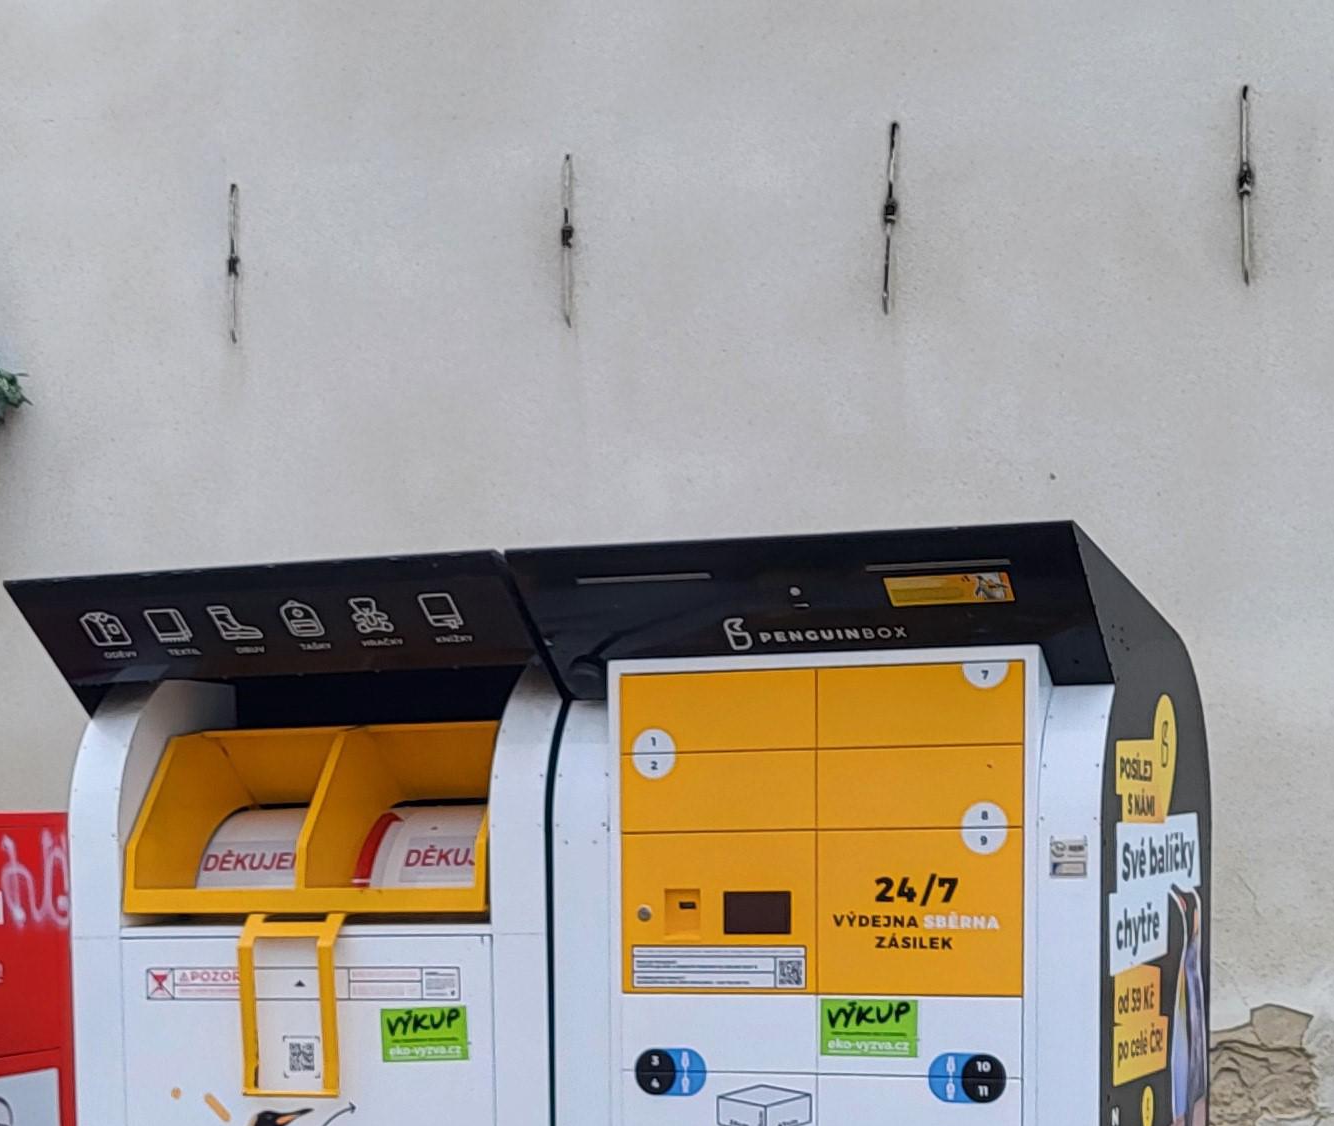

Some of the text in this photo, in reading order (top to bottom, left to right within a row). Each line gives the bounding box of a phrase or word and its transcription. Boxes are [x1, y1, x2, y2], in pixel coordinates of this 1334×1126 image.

[758, 626, 908, 643] PENGUINBOX
[980, 669, 989, 680] 7
[650, 736, 657, 747] 1
[650, 760, 658, 770] 2
[1119, 753, 1153, 782] POSÍLEJ
[1127, 792, 1155, 817] S NÁMI
[981, 811, 988, 821] 8
[980, 835, 988, 846] 9
[1121, 832, 1195, 882] Své balíčky
[874, 873, 959, 907] 24/7
[833, 911, 1000, 930] VÝDEJNA SBĚRNA
[1116, 902, 1160, 957] chytře
[874, 933, 953, 950] ZÁSILEK
[1117, 984, 1155, 1014] od 59 Kč
[386, 1007, 461, 1037] VÝKUP
[827, 1001, 911, 1029] VÝKUP
[827, 1038, 911, 1053] eko-vyzva.cz
[1117, 1040, 1128, 1067] po
[1130, 1030, 1147, 1057] celé
[650, 1055, 660, 1066] 3
[975, 1061, 992, 1073] 10
[650, 1078, 660, 1089] 4
[976, 1085, 990, 1098] 11
